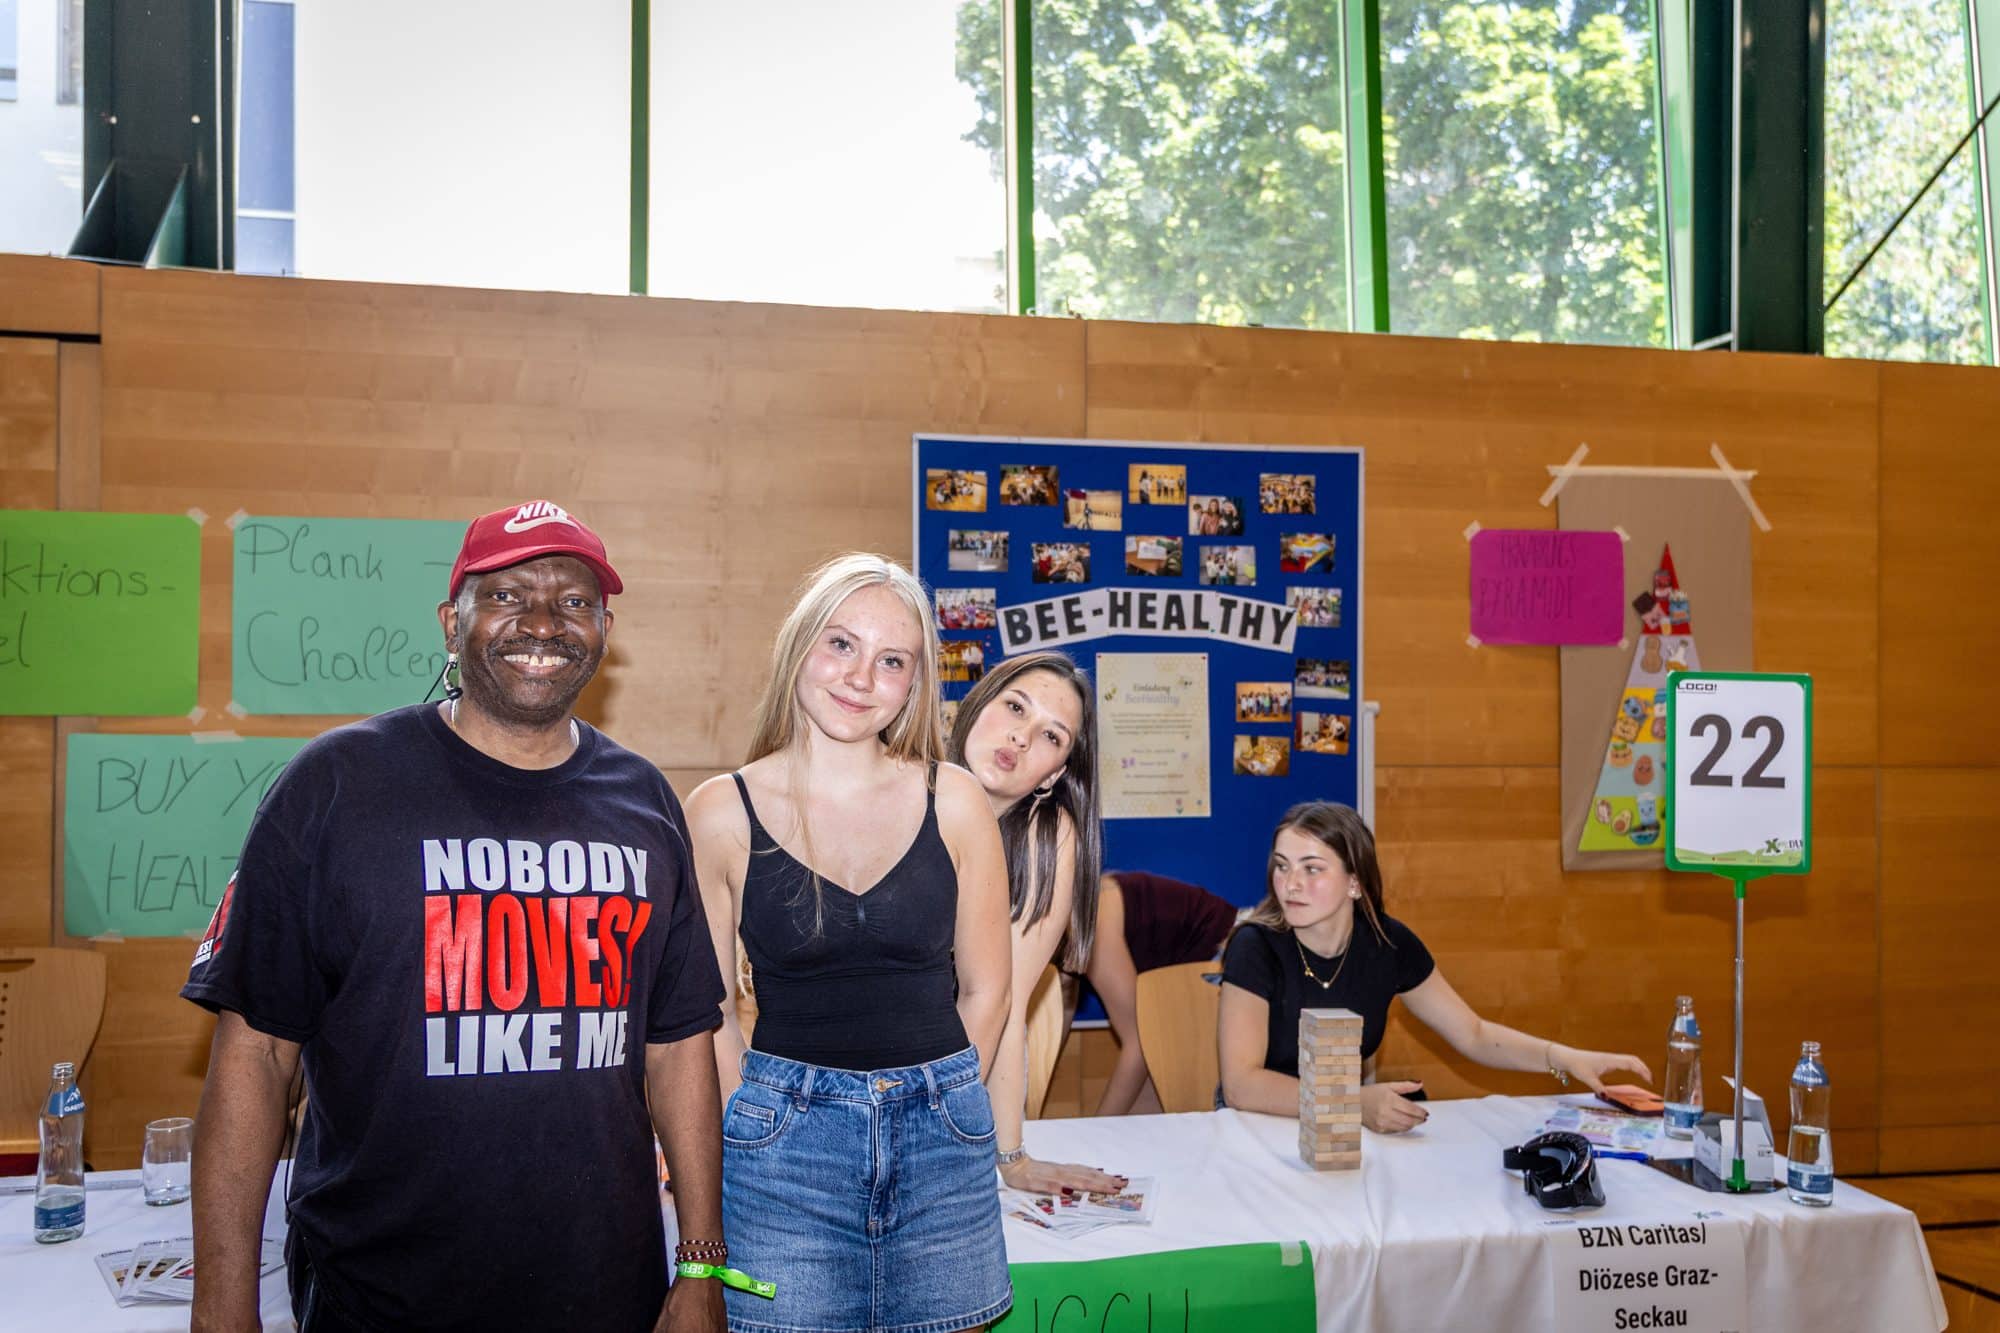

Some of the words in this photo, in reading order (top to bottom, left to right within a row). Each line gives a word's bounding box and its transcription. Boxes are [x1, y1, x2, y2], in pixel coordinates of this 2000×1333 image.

[239, 524, 383, 582] Plank
[1003, 590, 1295, 647] BEE-HEALTHY
[1677, 683, 1718, 691] LOGO!
[1689, 713, 1786, 789] 22
[96, 757, 208, 815] BUY
[223, 757, 288, 816] Y
[422, 838, 648, 898] NOBODY
[424, 893, 653, 1013] MOVES!
[425, 1012, 562, 1077] LIKE
[576, 1010, 628, 1070] ME
[1578, 1226, 1624, 1248] BZN
[1579, 1268, 1659, 1291] Diözese
[1665, 1265, 1719, 1286] Graz-
[1615, 1305, 1688, 1329] Seckau
